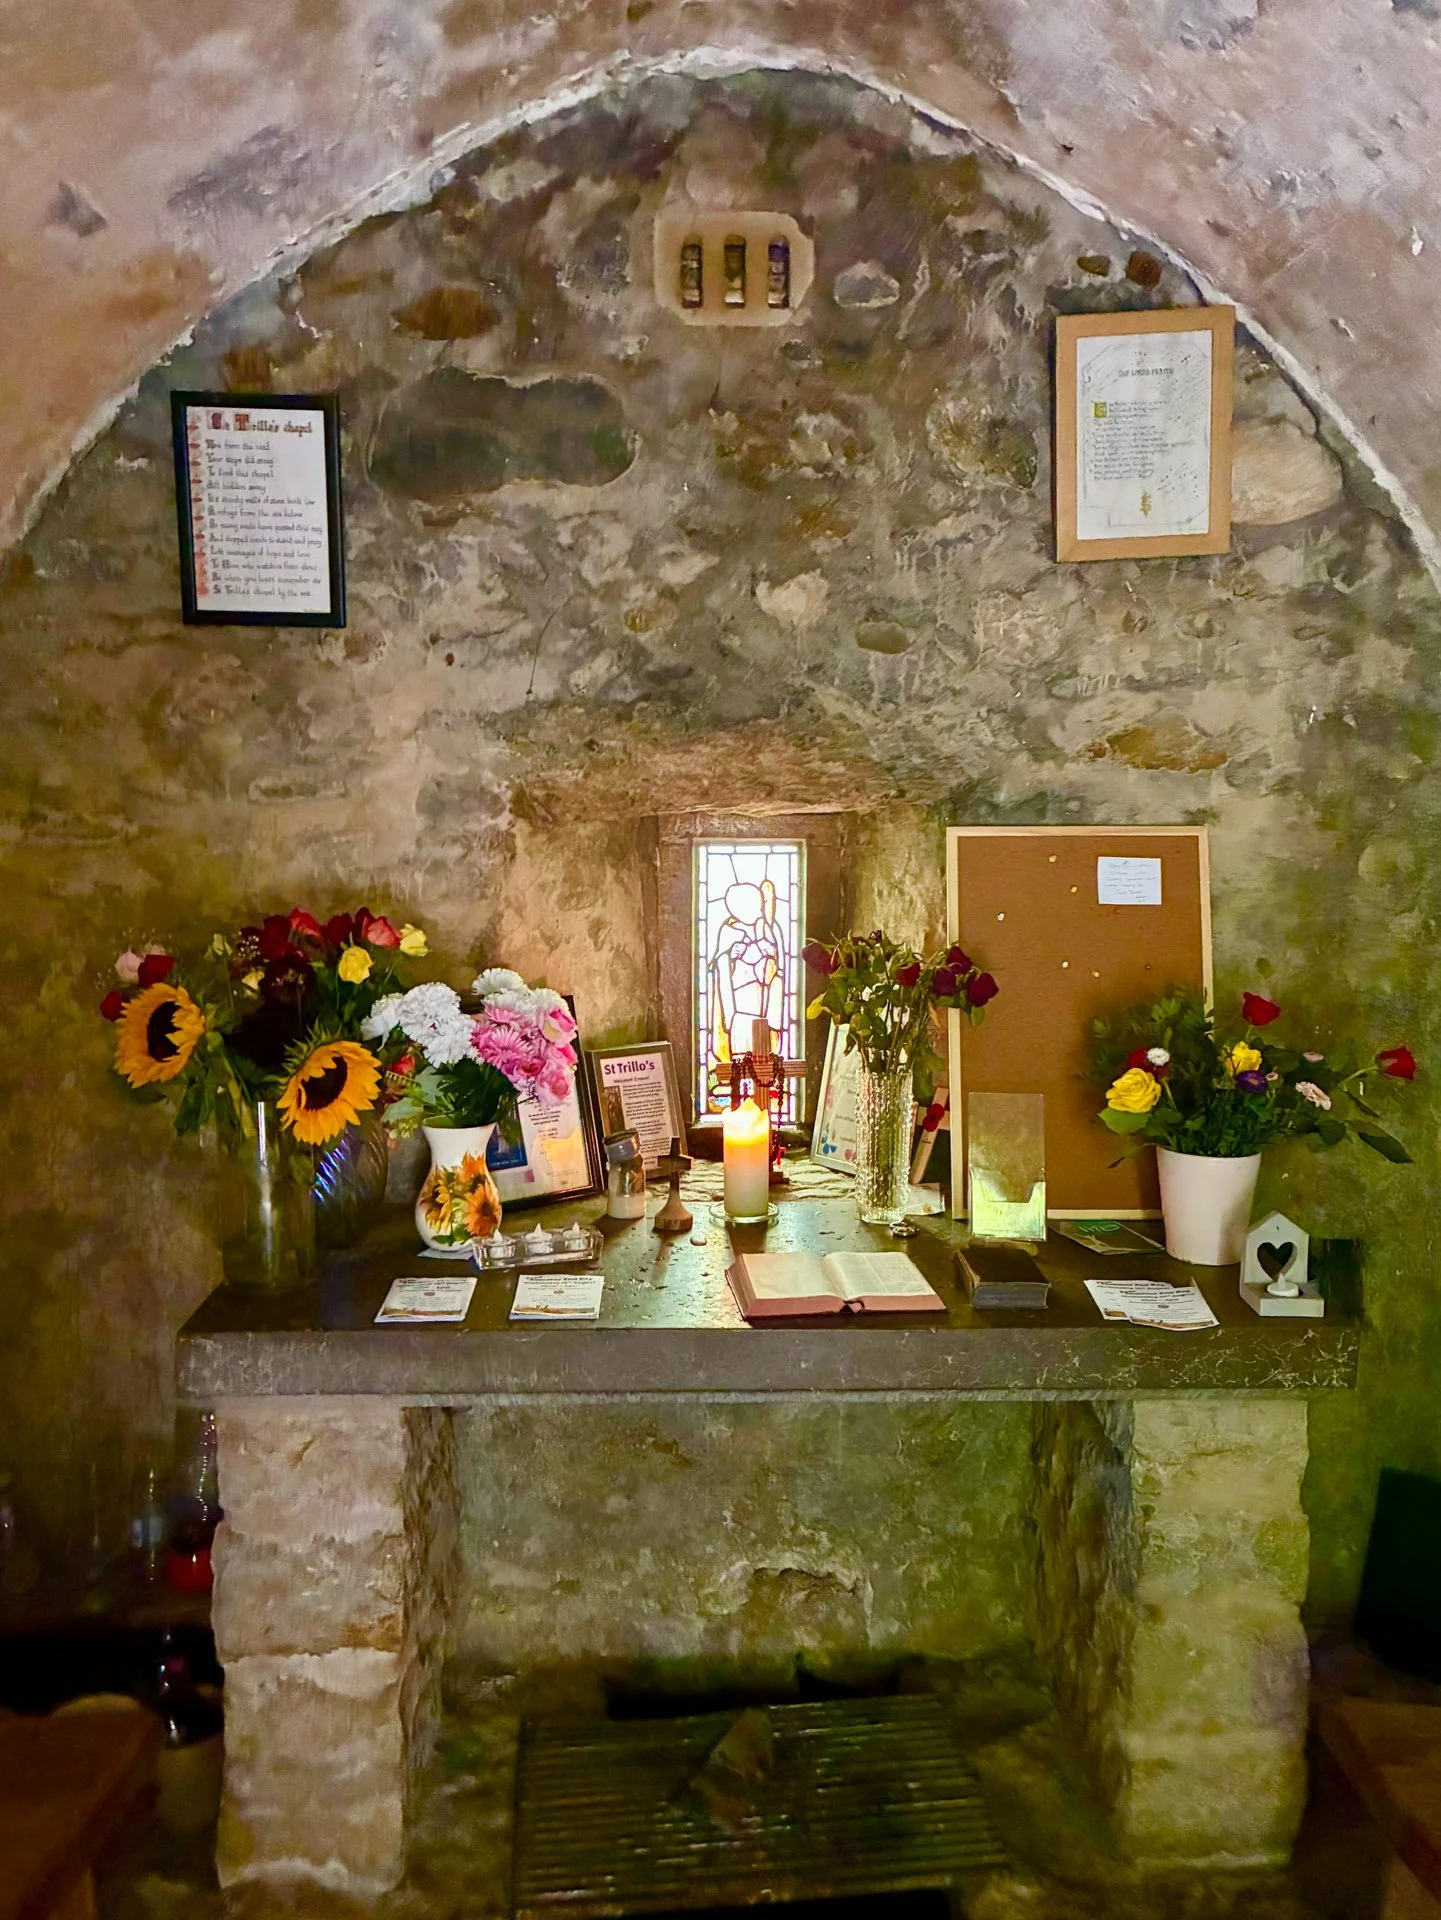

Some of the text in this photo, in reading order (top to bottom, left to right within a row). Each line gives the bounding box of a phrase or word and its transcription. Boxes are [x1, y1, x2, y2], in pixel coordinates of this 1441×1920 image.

[210, 411, 313, 437] St Trillo's chapel
[206, 453, 223, 463] Your
[207, 466, 274, 480] To find this chapel
[222, 480, 246, 491] hidden
[240, 508, 256, 517] from
[258, 508, 269, 517] the
[224, 574, 242, 582] when
[604, 1060, 655, 1075] St Trillo's
